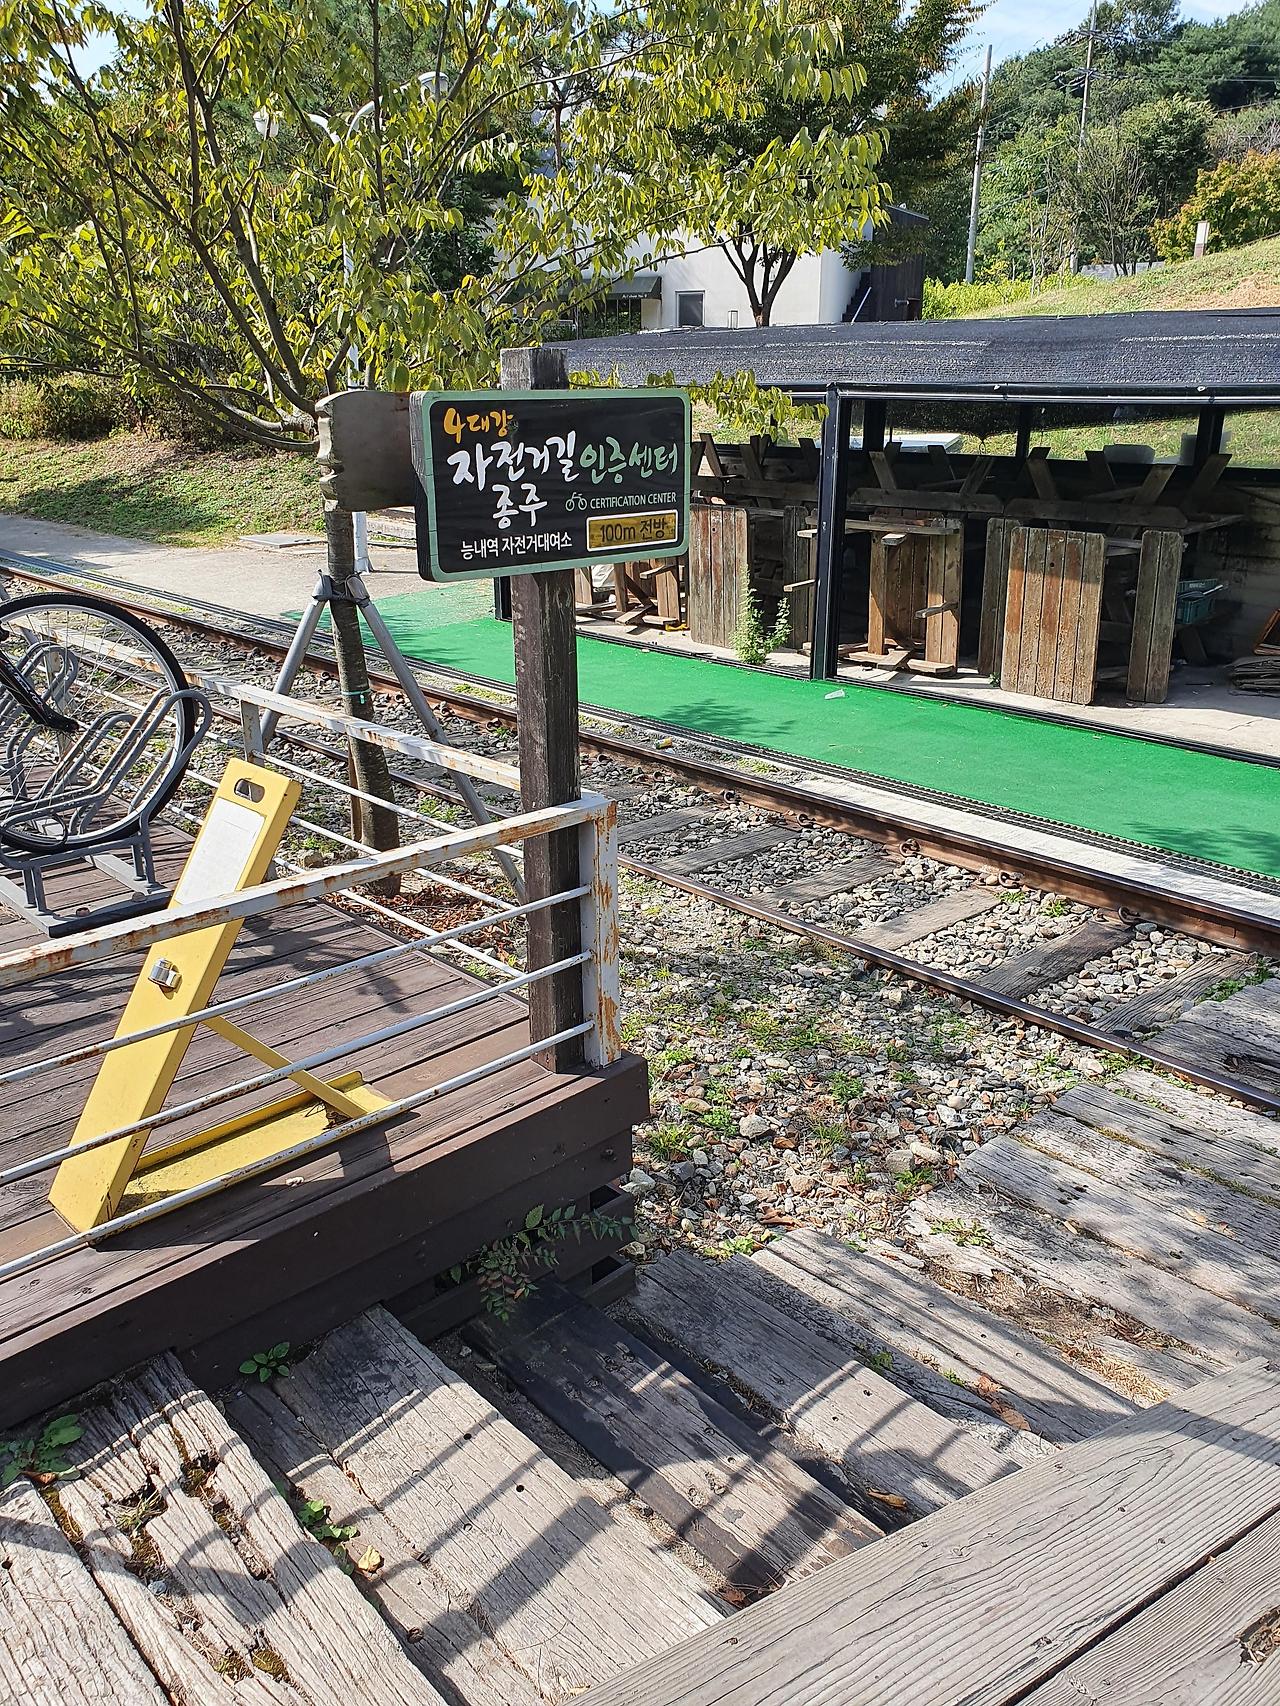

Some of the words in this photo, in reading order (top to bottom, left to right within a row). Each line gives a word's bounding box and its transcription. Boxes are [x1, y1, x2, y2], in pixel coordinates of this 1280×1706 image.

[444, 407, 514, 443] 4대강
[446, 430, 579, 490] 자전거길
[580, 436, 678, 484] 인증센터
[492, 483, 548, 529] 종주
[590, 495, 646, 509] CERTIFICATION
[647, 492, 677, 504] CENTER
[460, 537, 499, 560] 능내역
[501, 531, 573, 555] 자전거대여소
[600, 523, 636, 543] 100m
[639, 517, 668, 540] 전방
